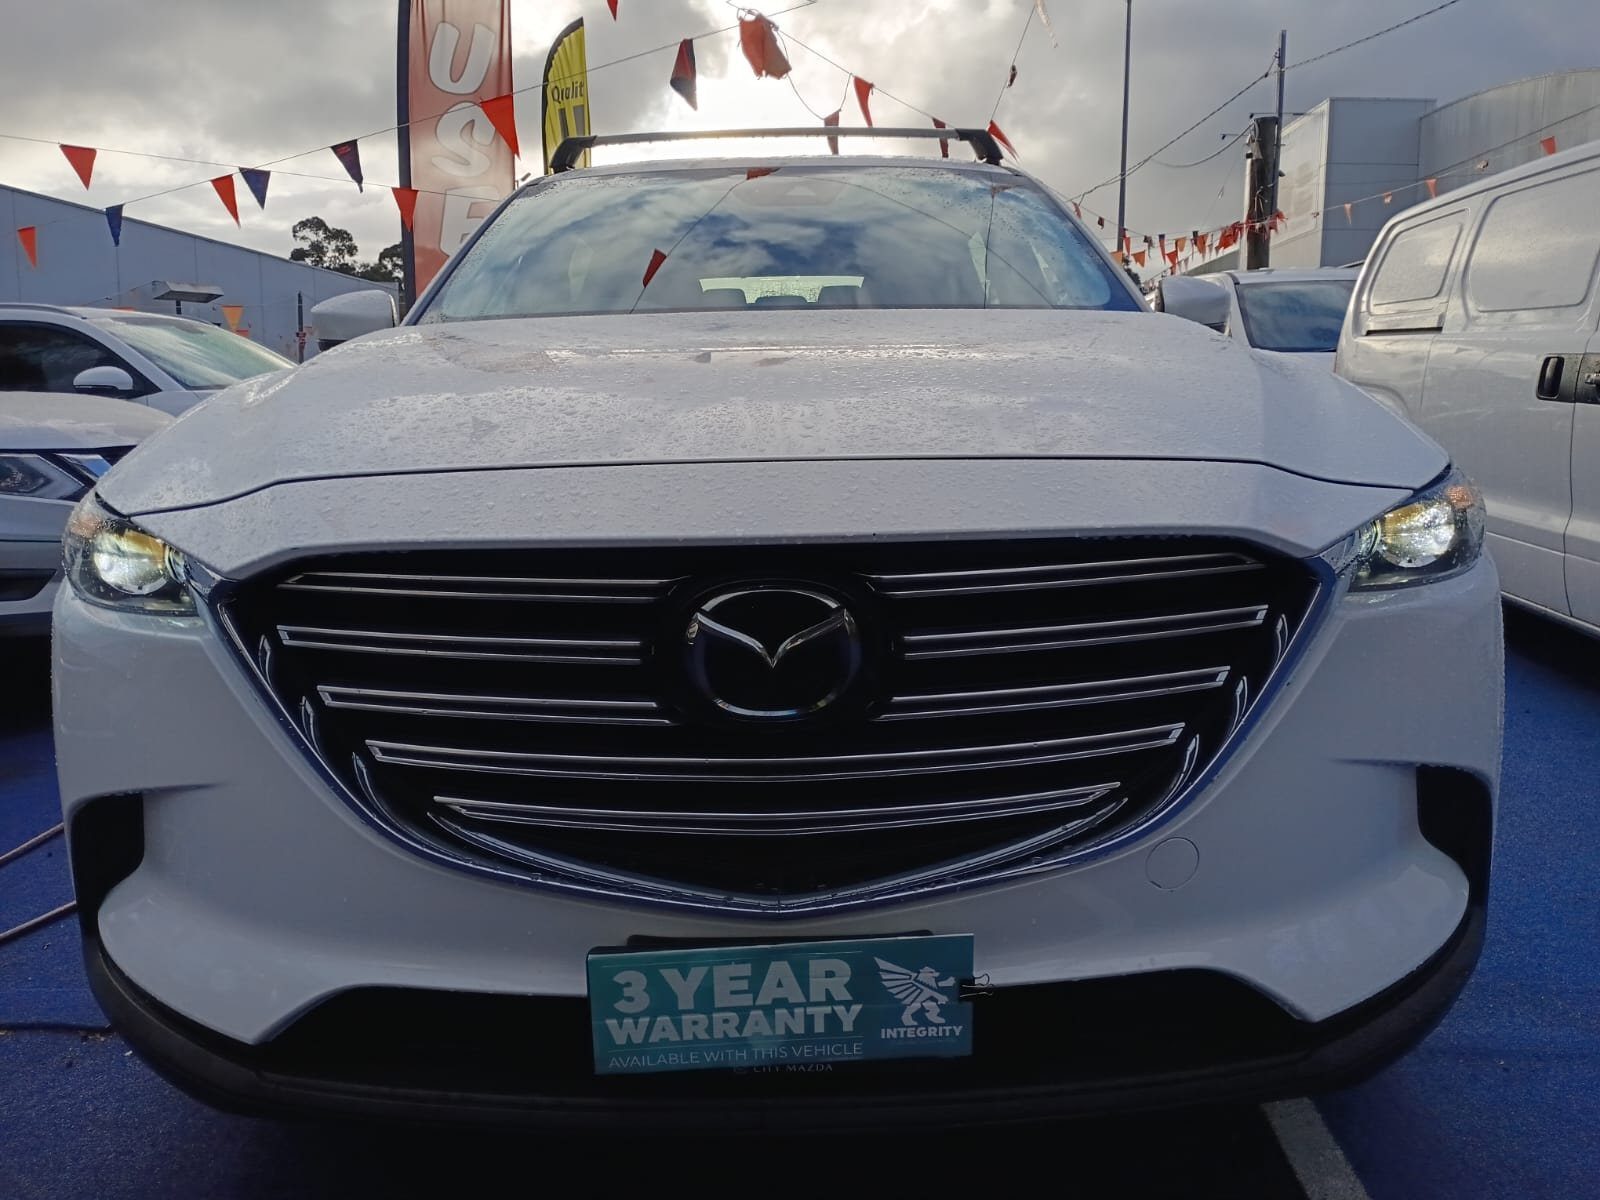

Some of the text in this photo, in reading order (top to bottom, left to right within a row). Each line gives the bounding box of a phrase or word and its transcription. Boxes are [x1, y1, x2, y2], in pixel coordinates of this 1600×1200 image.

[613, 958, 853, 1014] 3 YEAR
[605, 1004, 863, 1045] WARRANTY
[880, 1025, 963, 1039] INTEGRITY
[608, 1043, 863, 1068] AVAILABLE WITH THIS VEHICLE
[786, 1064, 833, 1073] MAZDA
